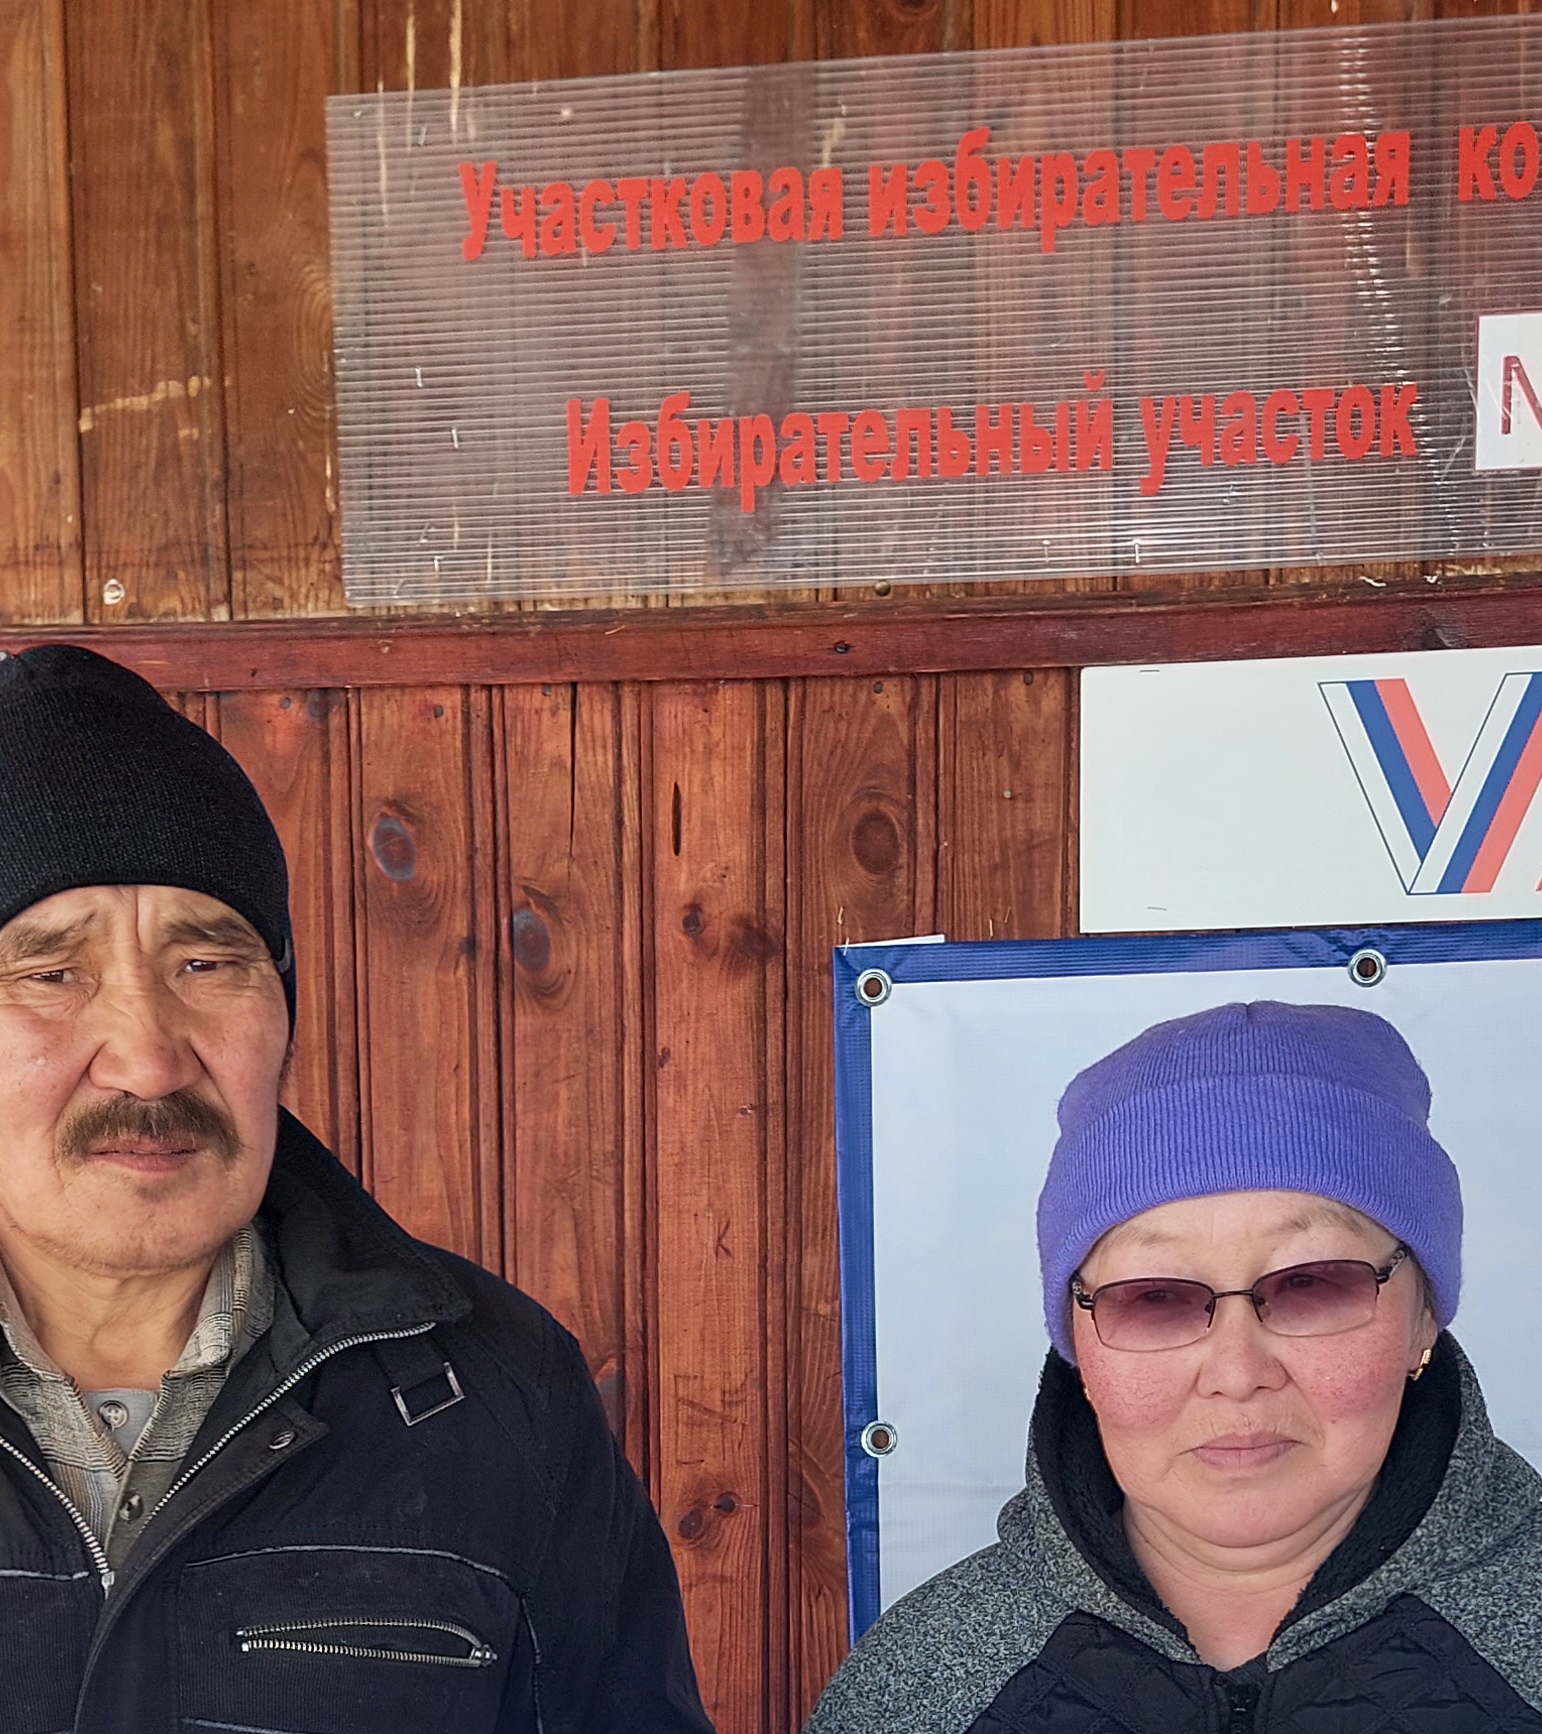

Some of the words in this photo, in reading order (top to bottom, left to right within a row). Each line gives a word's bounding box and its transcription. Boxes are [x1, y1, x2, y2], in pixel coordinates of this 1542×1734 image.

[459, 161, 843, 260] Участковая
[868, 127, 1411, 253] избирательная
[567, 370, 1112, 512] Избирательный
[1141, 384, 1417, 496] участок
